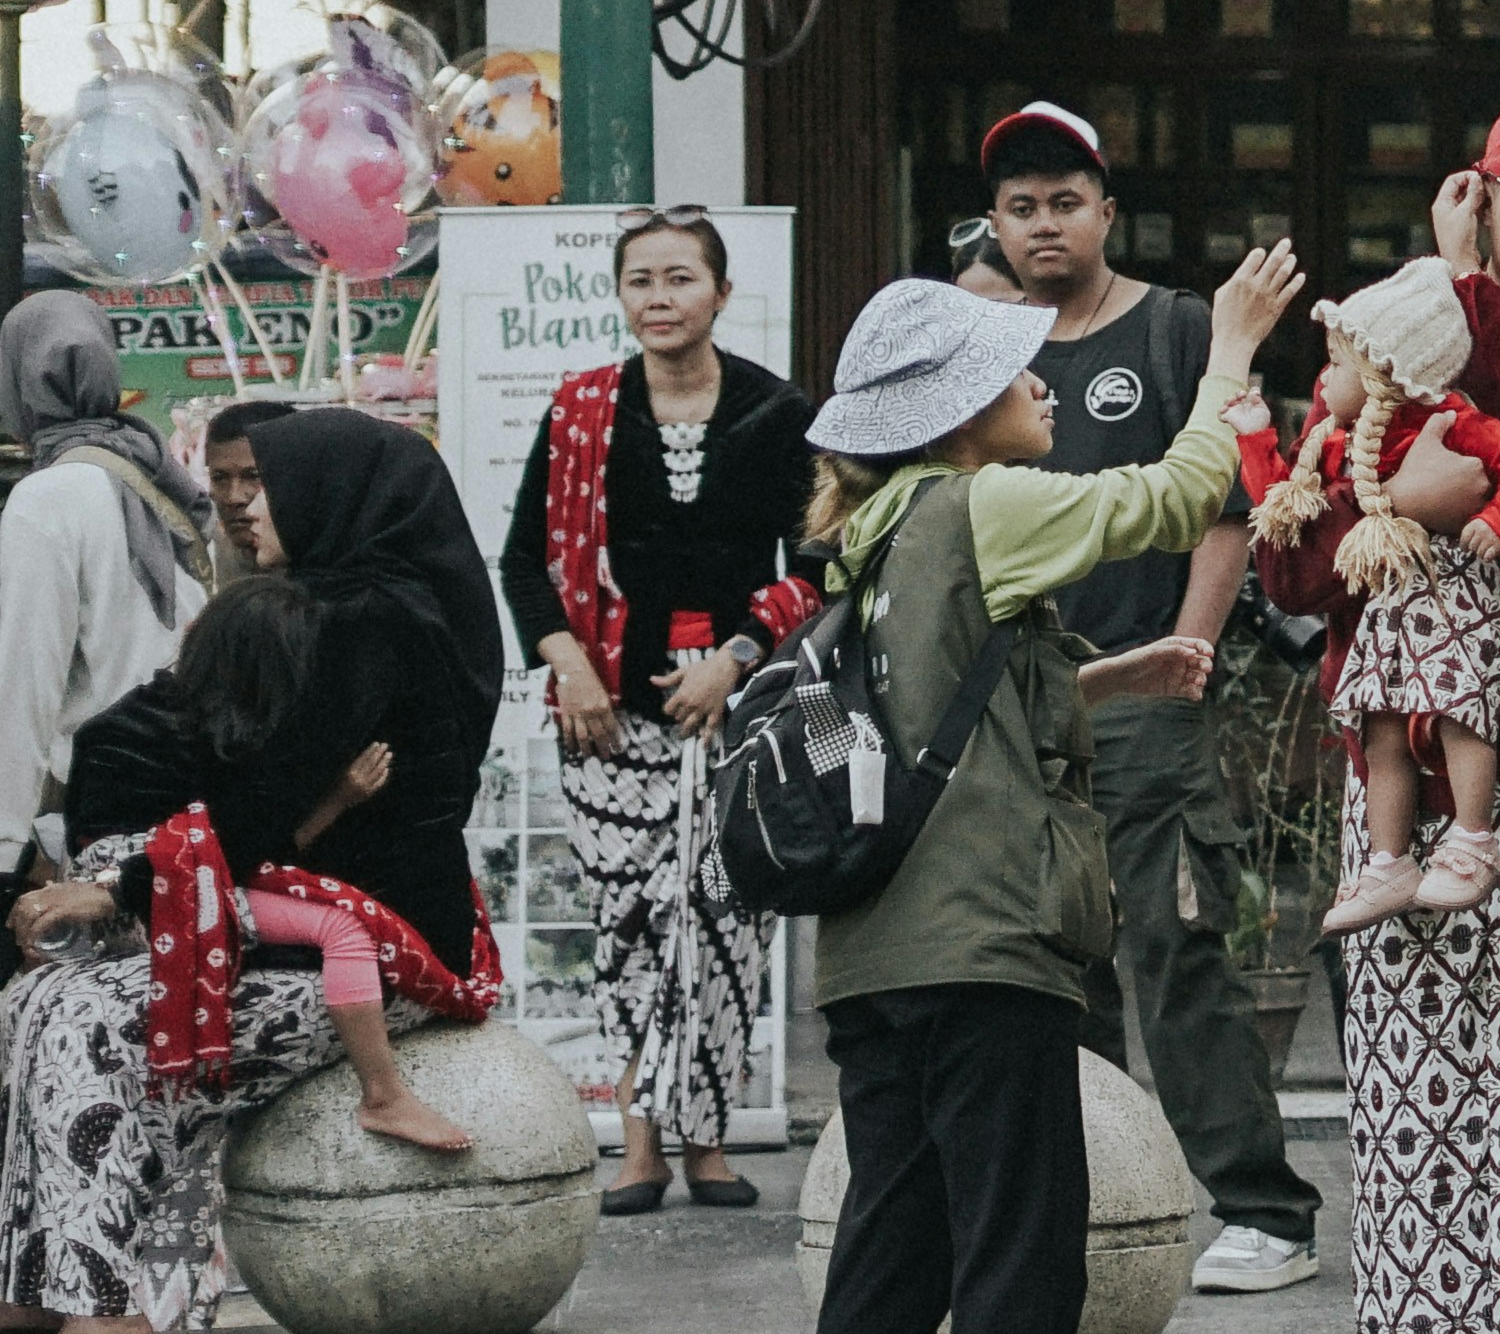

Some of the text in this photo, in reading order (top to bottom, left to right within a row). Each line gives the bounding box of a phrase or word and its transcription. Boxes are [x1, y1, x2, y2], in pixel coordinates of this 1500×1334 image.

[555, 231, 620, 248] KOPE
[524, 262, 618, 304] Poko
[500, 307, 634, 350] Blang
